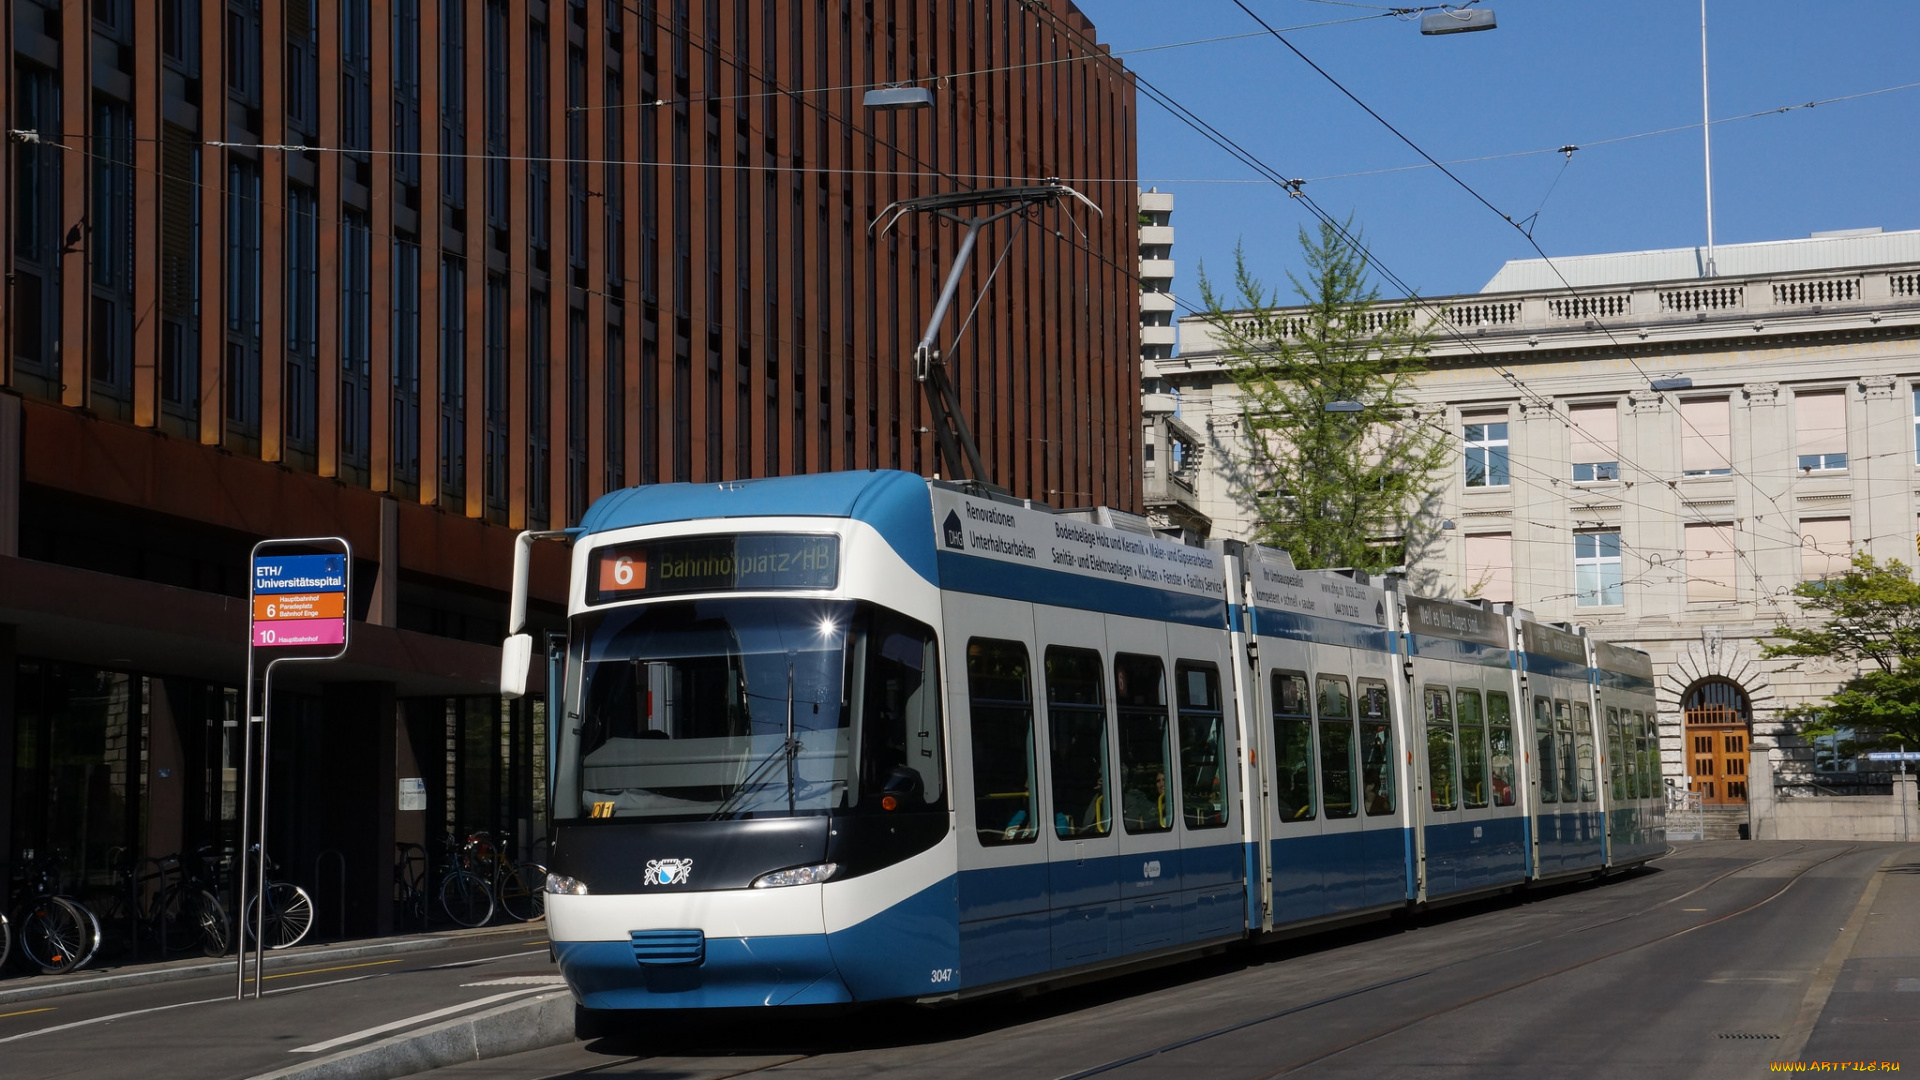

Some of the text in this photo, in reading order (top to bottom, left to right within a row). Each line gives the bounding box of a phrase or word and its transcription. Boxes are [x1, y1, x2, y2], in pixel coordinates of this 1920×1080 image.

[1601, 353, 1689, 370] INSTITUT
[1703, 350, 1739, 365] DER
[965, 501, 1016, 528] Renovationen
[948, 529, 963, 546] DHG
[969, 530, 1036, 560] Unterhaltsarbeiten
[1054, 521, 1096, 549] Bodenbeläge
[1095, 530, 1110, 548] Holz
[1110, 535, 1122, 550] und
[1121, 536, 1145, 556] Keramik
[1167, 547, 1177, 562] und
[1177, 548, 1214, 570] Gipserarbeiten
[256, 565, 283, 577] ETH/
[613, 545, 830, 586] 6 Bahnhofplatz/HB
[1051, 547, 1222, 594] Sanitär- und Elektroanlagen Küchen Fenster Facility Service
[256, 576, 342, 589] Universitätsspital
[1269, 568, 1304, 589] Umbauspezialist
[279, 595, 320, 604] Hauptbahnhof
[1255, 586, 1316, 611] kompetent schnell sauber
[266, 603, 313, 618] 6 Paradeplatz
[304, 610, 319, 618] Enge
[1418, 604, 1432, 625] Weil
[1432, 611, 1440, 627] es
[1439, 607, 1451, 628] Ihre
[1451, 610, 1468, 635] Augen
[260, 629, 319, 644] 10 Hauptbahnhof
[931, 968, 952, 983] 3047
